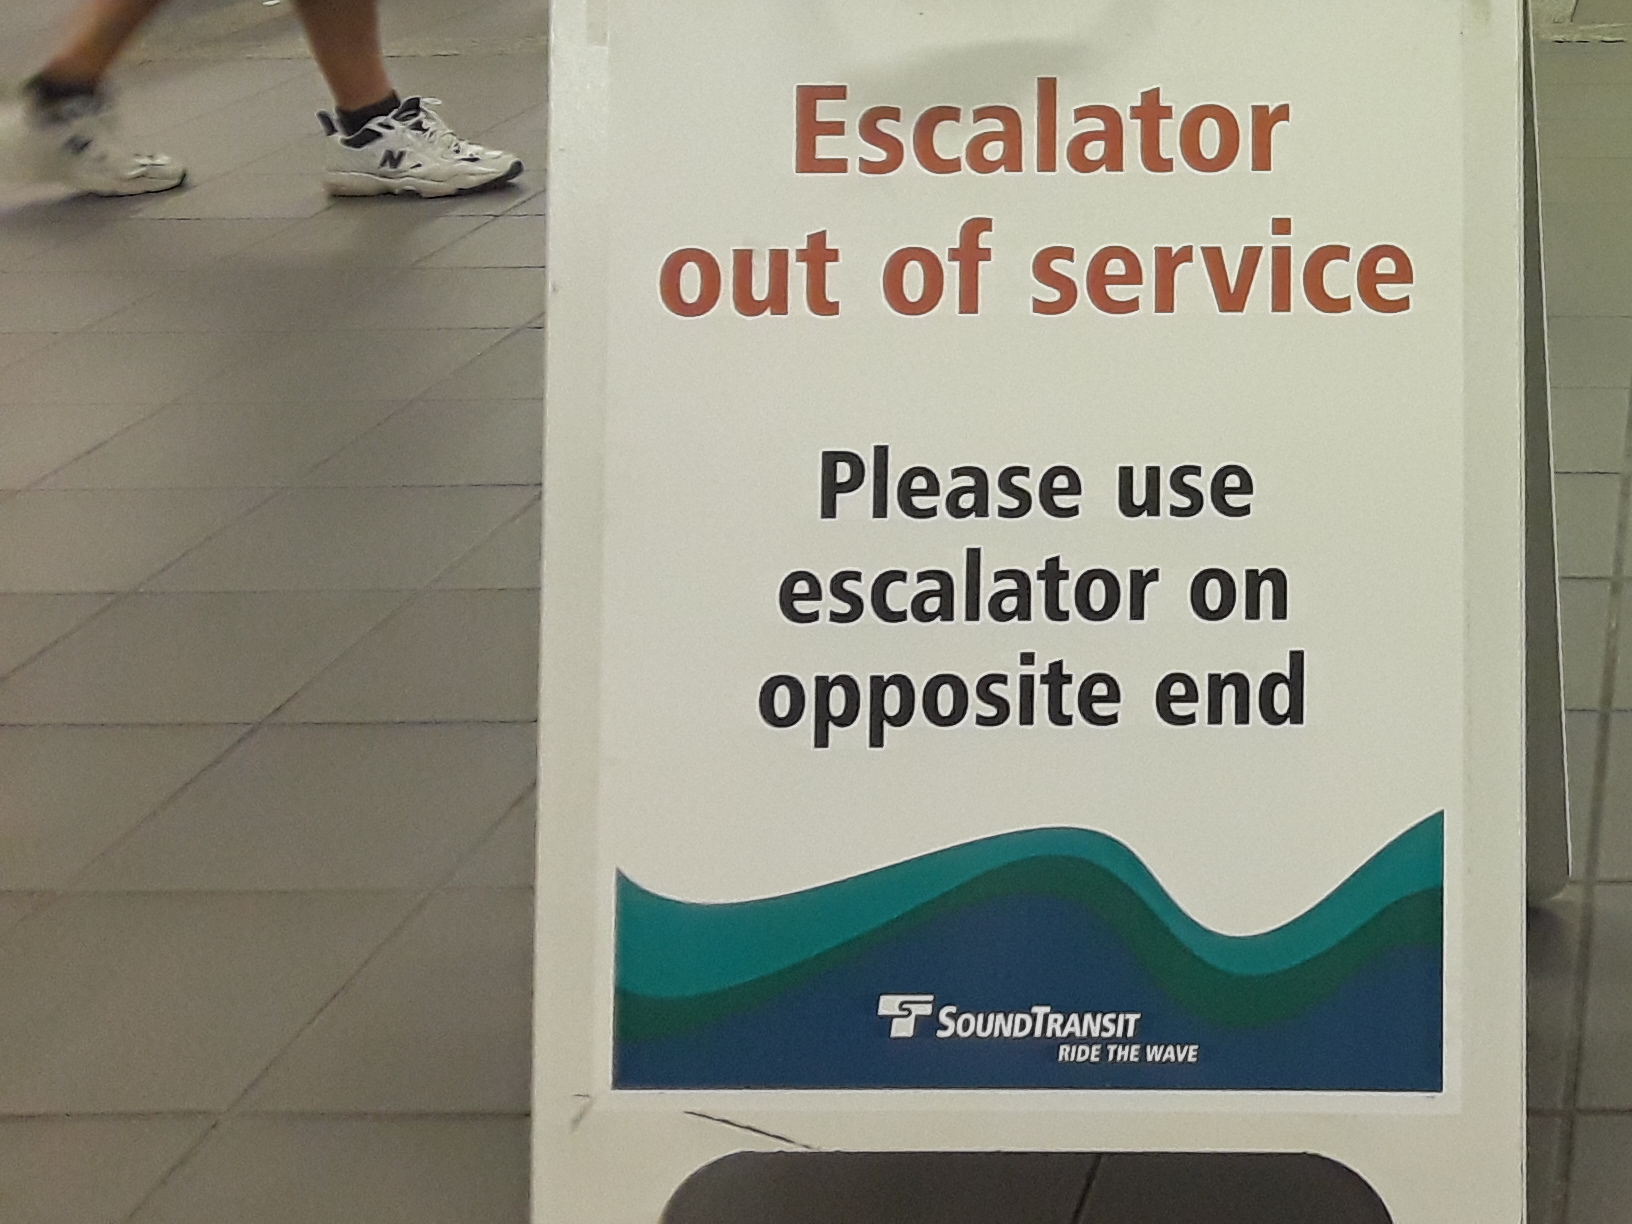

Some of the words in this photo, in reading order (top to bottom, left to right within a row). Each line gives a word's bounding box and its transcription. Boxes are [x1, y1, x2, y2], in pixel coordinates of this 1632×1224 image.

[797, 77, 1290, 176] Escalator
[659, 230, 840, 317] out
[883, 217, 993, 316] of
[1032, 217, 1415, 315] service
[819, 444, 1082, 520] Please
[1117, 463, 1254, 519] use
[778, 547, 1160, 624] escalator
[1190, 566, 1289, 622] on
[758, 651, 1121, 749] opposite
[1155, 649, 1306, 726] end
[1057, 1044, 1102, 1062] RIDE
[1107, 1044, 1141, 1062] THE
[1146, 1044, 1199, 1063] WAVE
